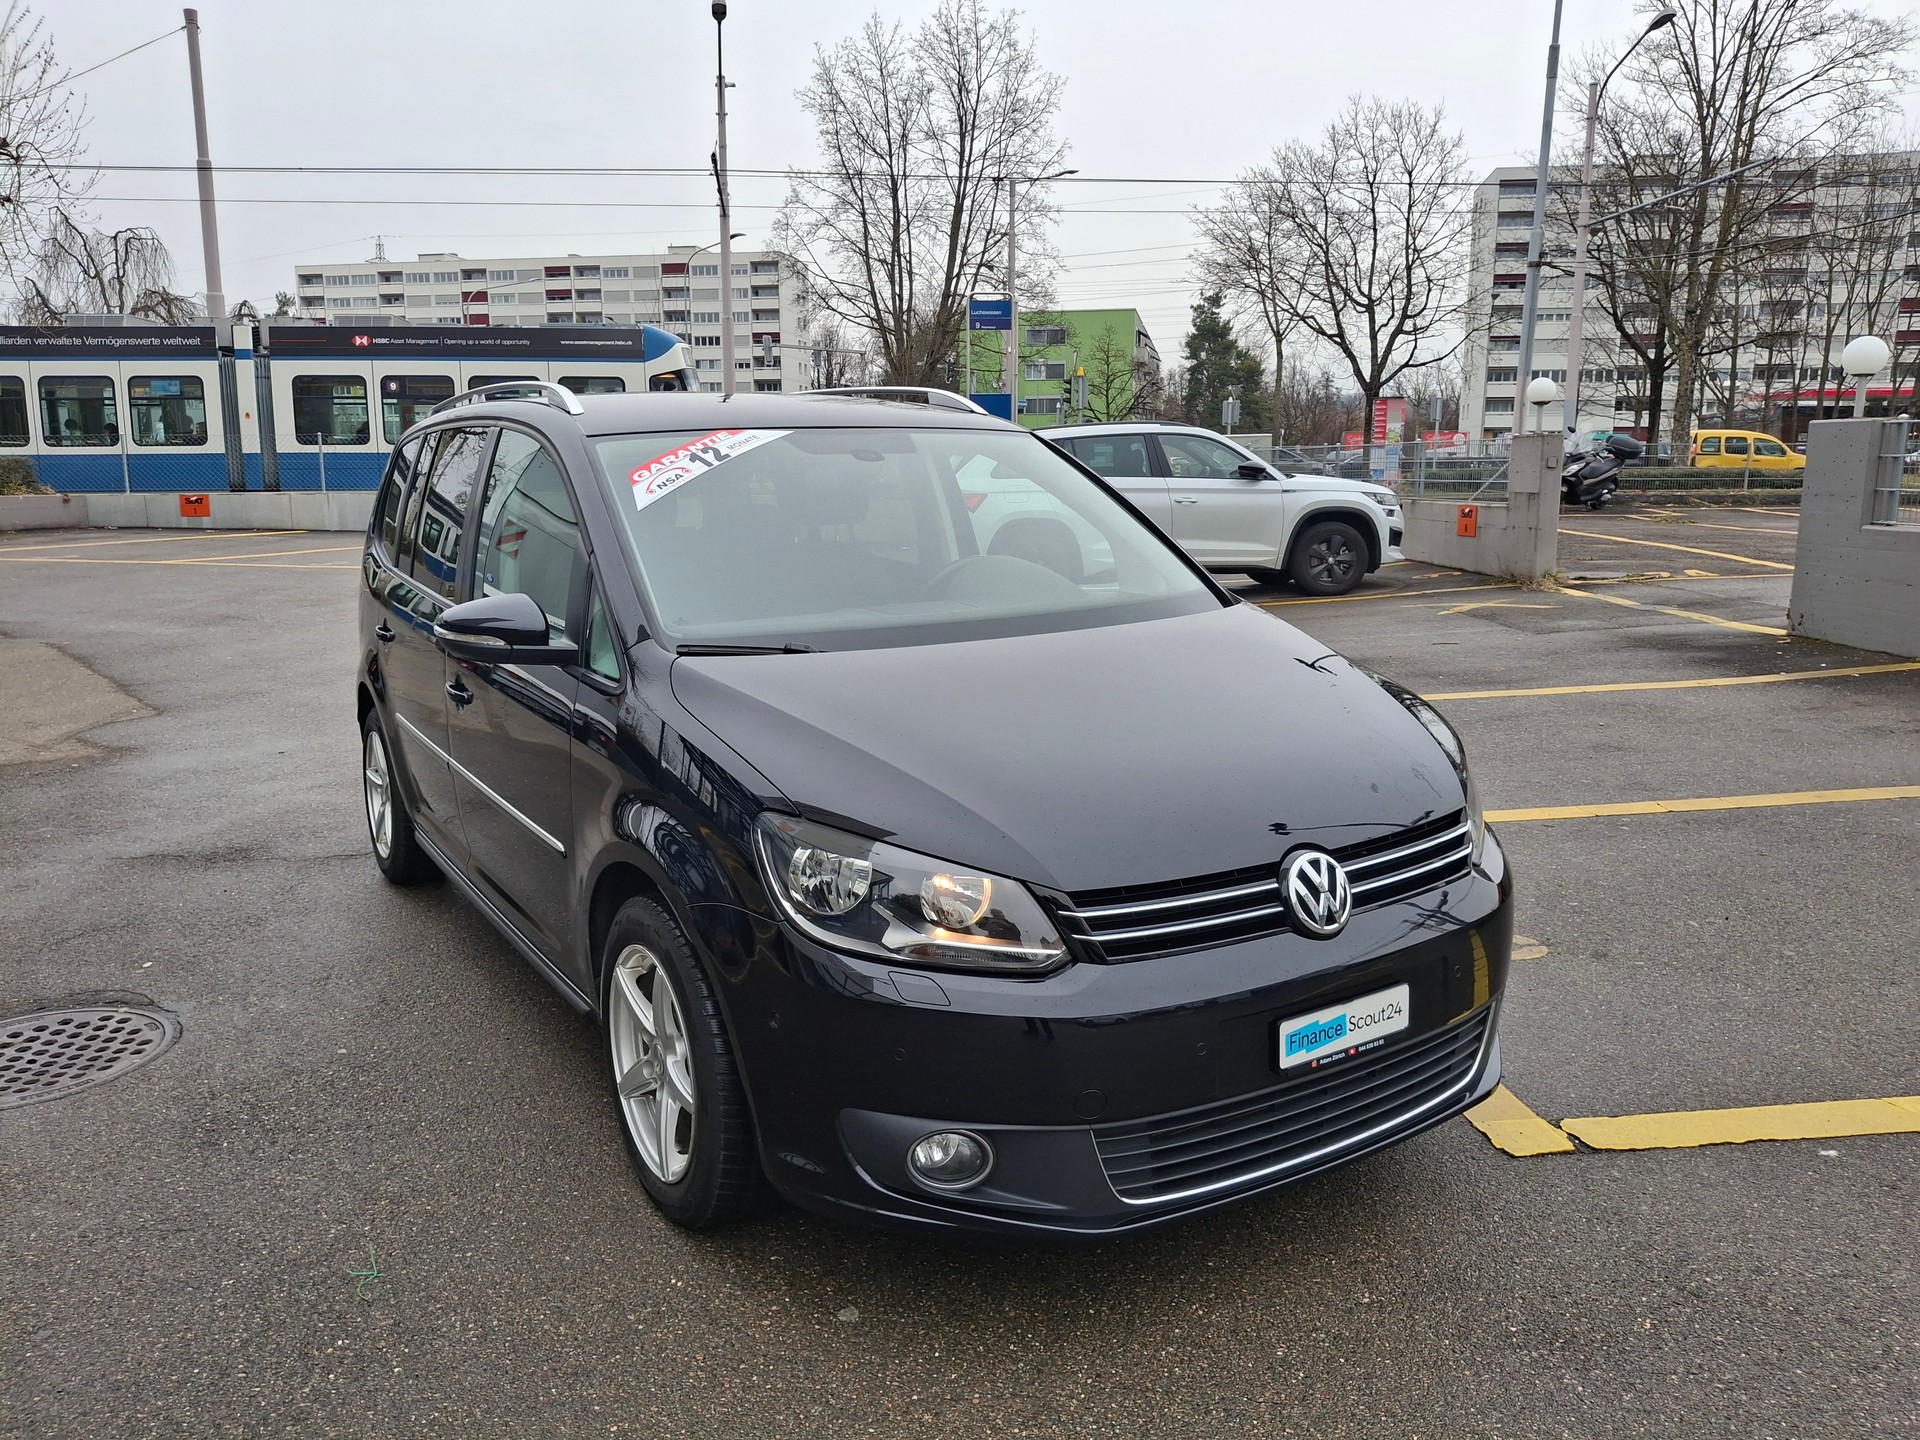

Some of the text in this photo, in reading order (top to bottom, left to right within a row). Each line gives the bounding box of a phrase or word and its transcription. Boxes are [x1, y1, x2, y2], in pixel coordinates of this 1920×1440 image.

[975, 321, 981, 329] 9
[34, 336, 82, 345] verwaltete
[83, 336, 161, 347] Vermögenswerte
[162, 336, 201, 346] weltweit
[405, 338, 439, 346] Management
[444, 338, 466, 346] Opening
[501, 338, 531, 347] opportunity
[389, 382, 397, 391] 9
[632, 431, 733, 482] GARANTIE
[688, 434, 761, 468] 12 MONATE
[656, 473, 685, 490] NSA
[1289, 1001, 1403, 1052] Finance Scout24
